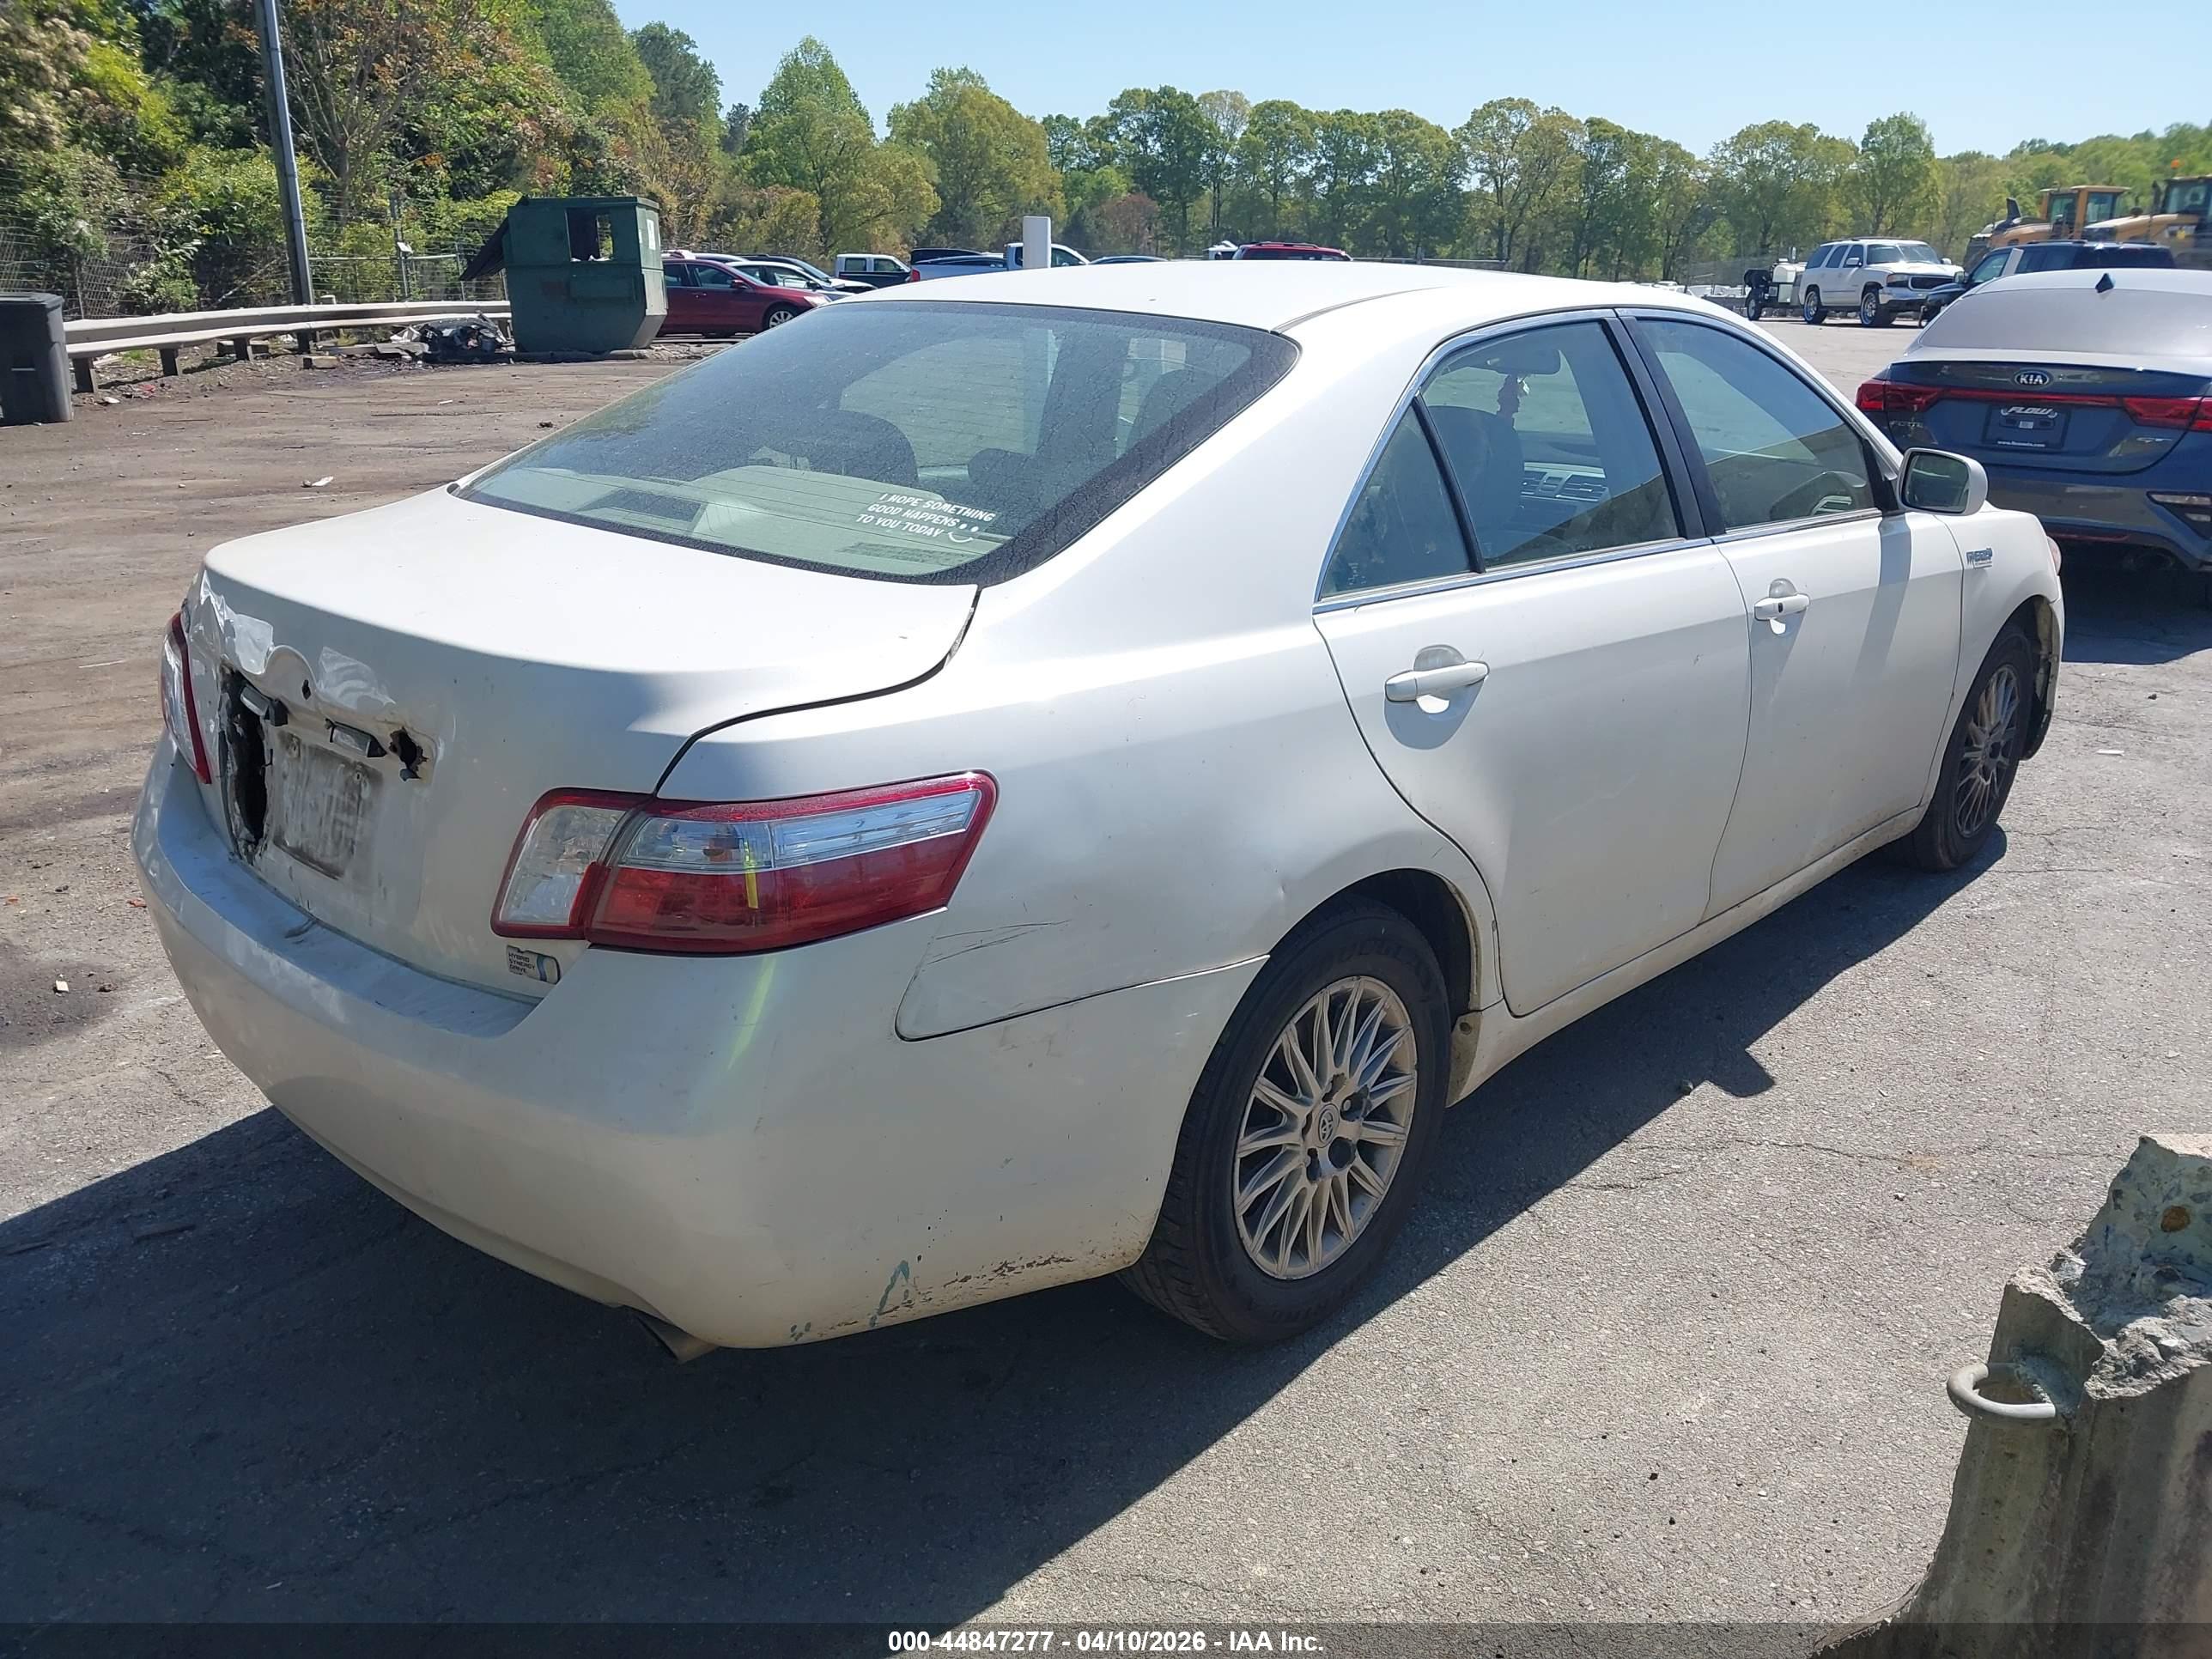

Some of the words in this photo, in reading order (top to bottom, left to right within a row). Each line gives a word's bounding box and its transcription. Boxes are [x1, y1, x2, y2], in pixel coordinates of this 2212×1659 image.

[2020, 374, 2044, 385] KIA
[867, 503, 903, 515] GOOD
[902, 508, 960, 527] HAPPENS
[887, 495, 924, 507] HOPE
[922, 501, 996, 522] SOMETHING
[855, 514, 875, 524] TO
[875, 517, 902, 529] YOU
[902, 521, 945, 538] TODAY
[508, 952, 530, 963] HYBRID
